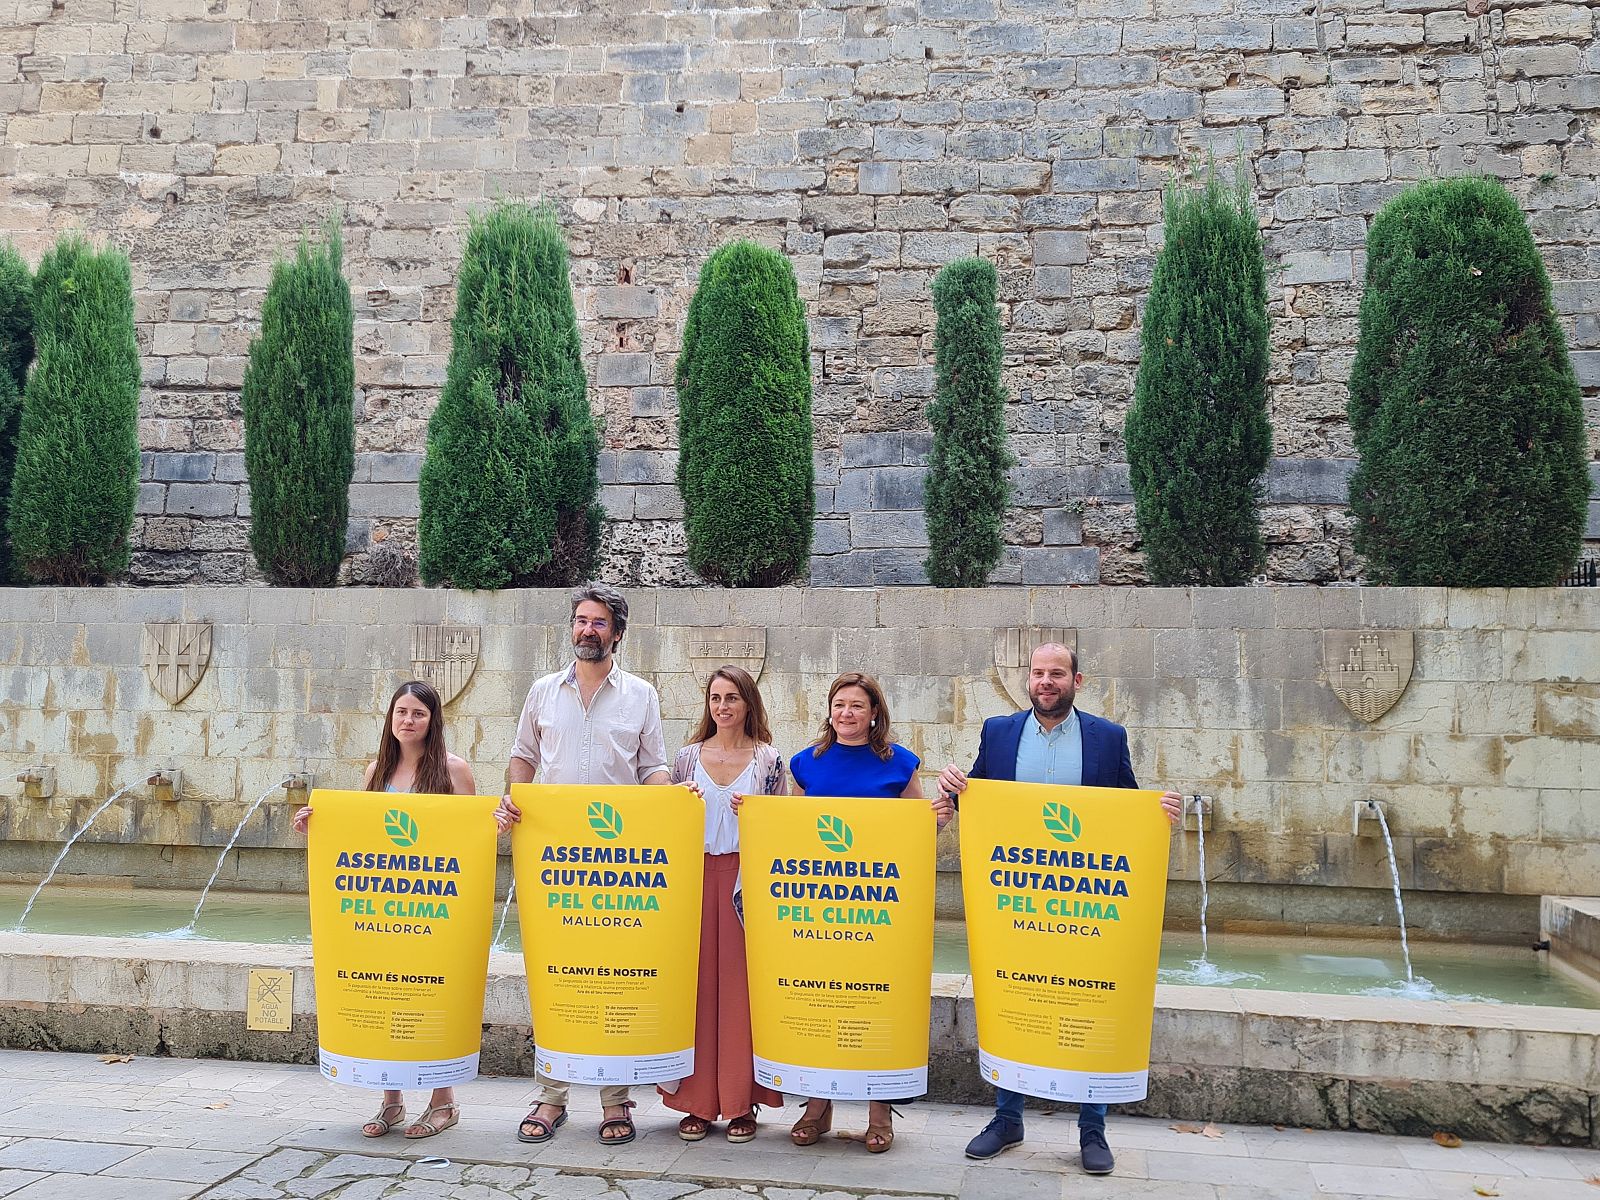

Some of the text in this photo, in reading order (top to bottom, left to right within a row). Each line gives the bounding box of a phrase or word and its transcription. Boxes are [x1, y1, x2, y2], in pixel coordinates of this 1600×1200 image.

[336, 852, 461, 873] ASSEMBLEA
[541, 846, 668, 864] ASSEMBLEA
[991, 846, 1131, 872] ASSEMBLEA
[770, 859, 900, 878] ASSEMBLEA
[335, 875, 458, 896] CIUTADANA
[541, 869, 667, 888] CIUTADANA
[990, 870, 1129, 897] CIUTADANA
[770, 882, 899, 902] CIUTADANA
[341, 898, 449, 919] PEL CLIMA
[548, 893, 659, 911] PEL CLIMA
[998, 894, 1120, 921] PEL CLIMA
[563, 916, 642, 927] MALLORCA
[778, 905, 891, 925] PEL CLIMA
[354, 922, 432, 934] MALLORCA
[793, 929, 874, 941] MALLORCA
[1014, 919, 1101, 937] MALLORCA
[351, 972, 382, 981] CANVI
[386, 972, 398, 982] ÉS
[402, 975, 444, 984] NOSTRE
[562, 967, 594, 975] CANVI
[598, 966, 610, 976] ÉS
[997, 970, 1116, 990] EL CANVI ÉS NOSTRE
[793, 980, 825, 989] CANVI
[830, 980, 842, 989] ÉS
[846, 983, 889, 991] NOSTRE
